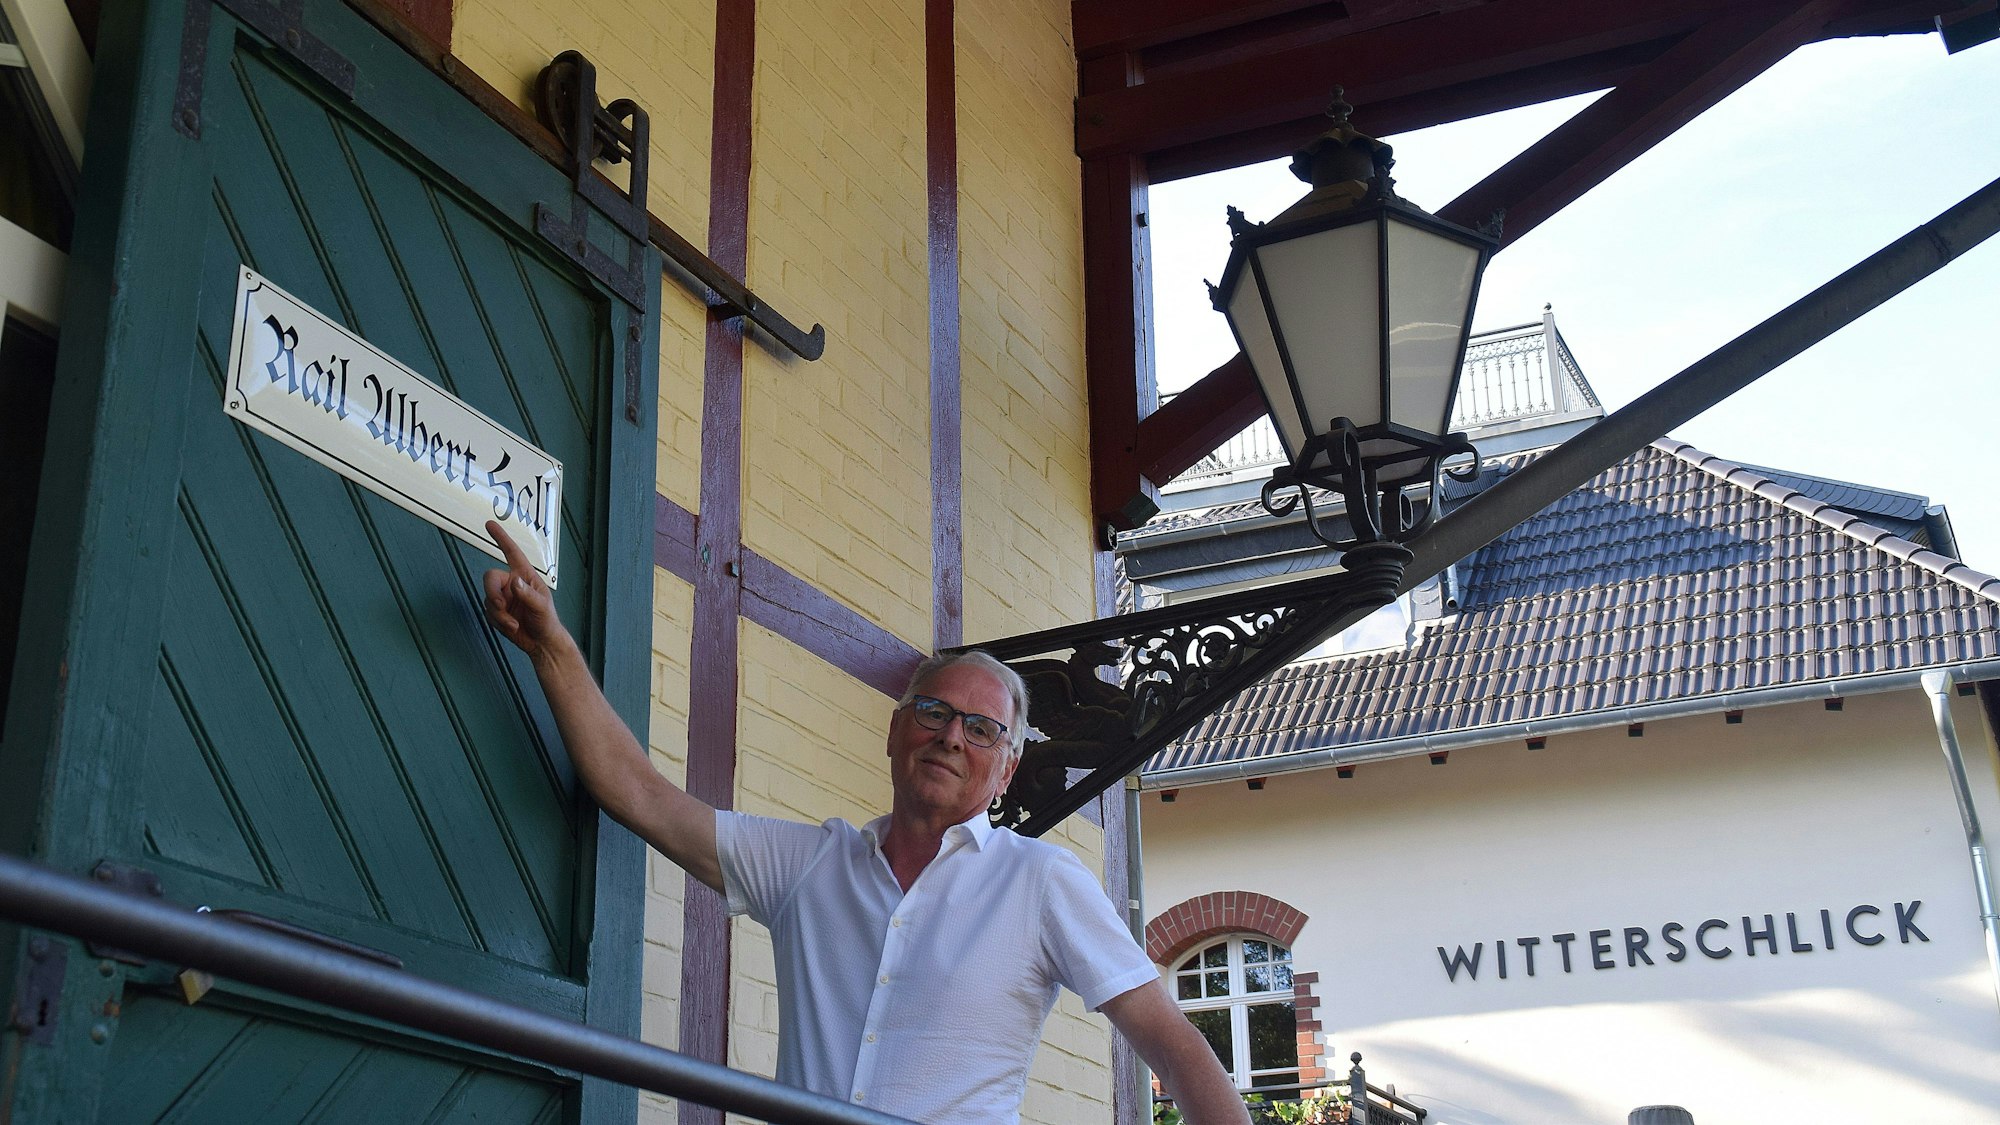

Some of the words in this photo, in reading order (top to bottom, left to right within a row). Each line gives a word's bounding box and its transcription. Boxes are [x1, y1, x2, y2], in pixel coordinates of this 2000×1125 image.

[263, 314, 349, 420] Rail
[363, 374, 475, 492] Albert
[487, 446, 552, 537] Hall
[1437, 900, 1930, 983] WITTERSCHLICK
